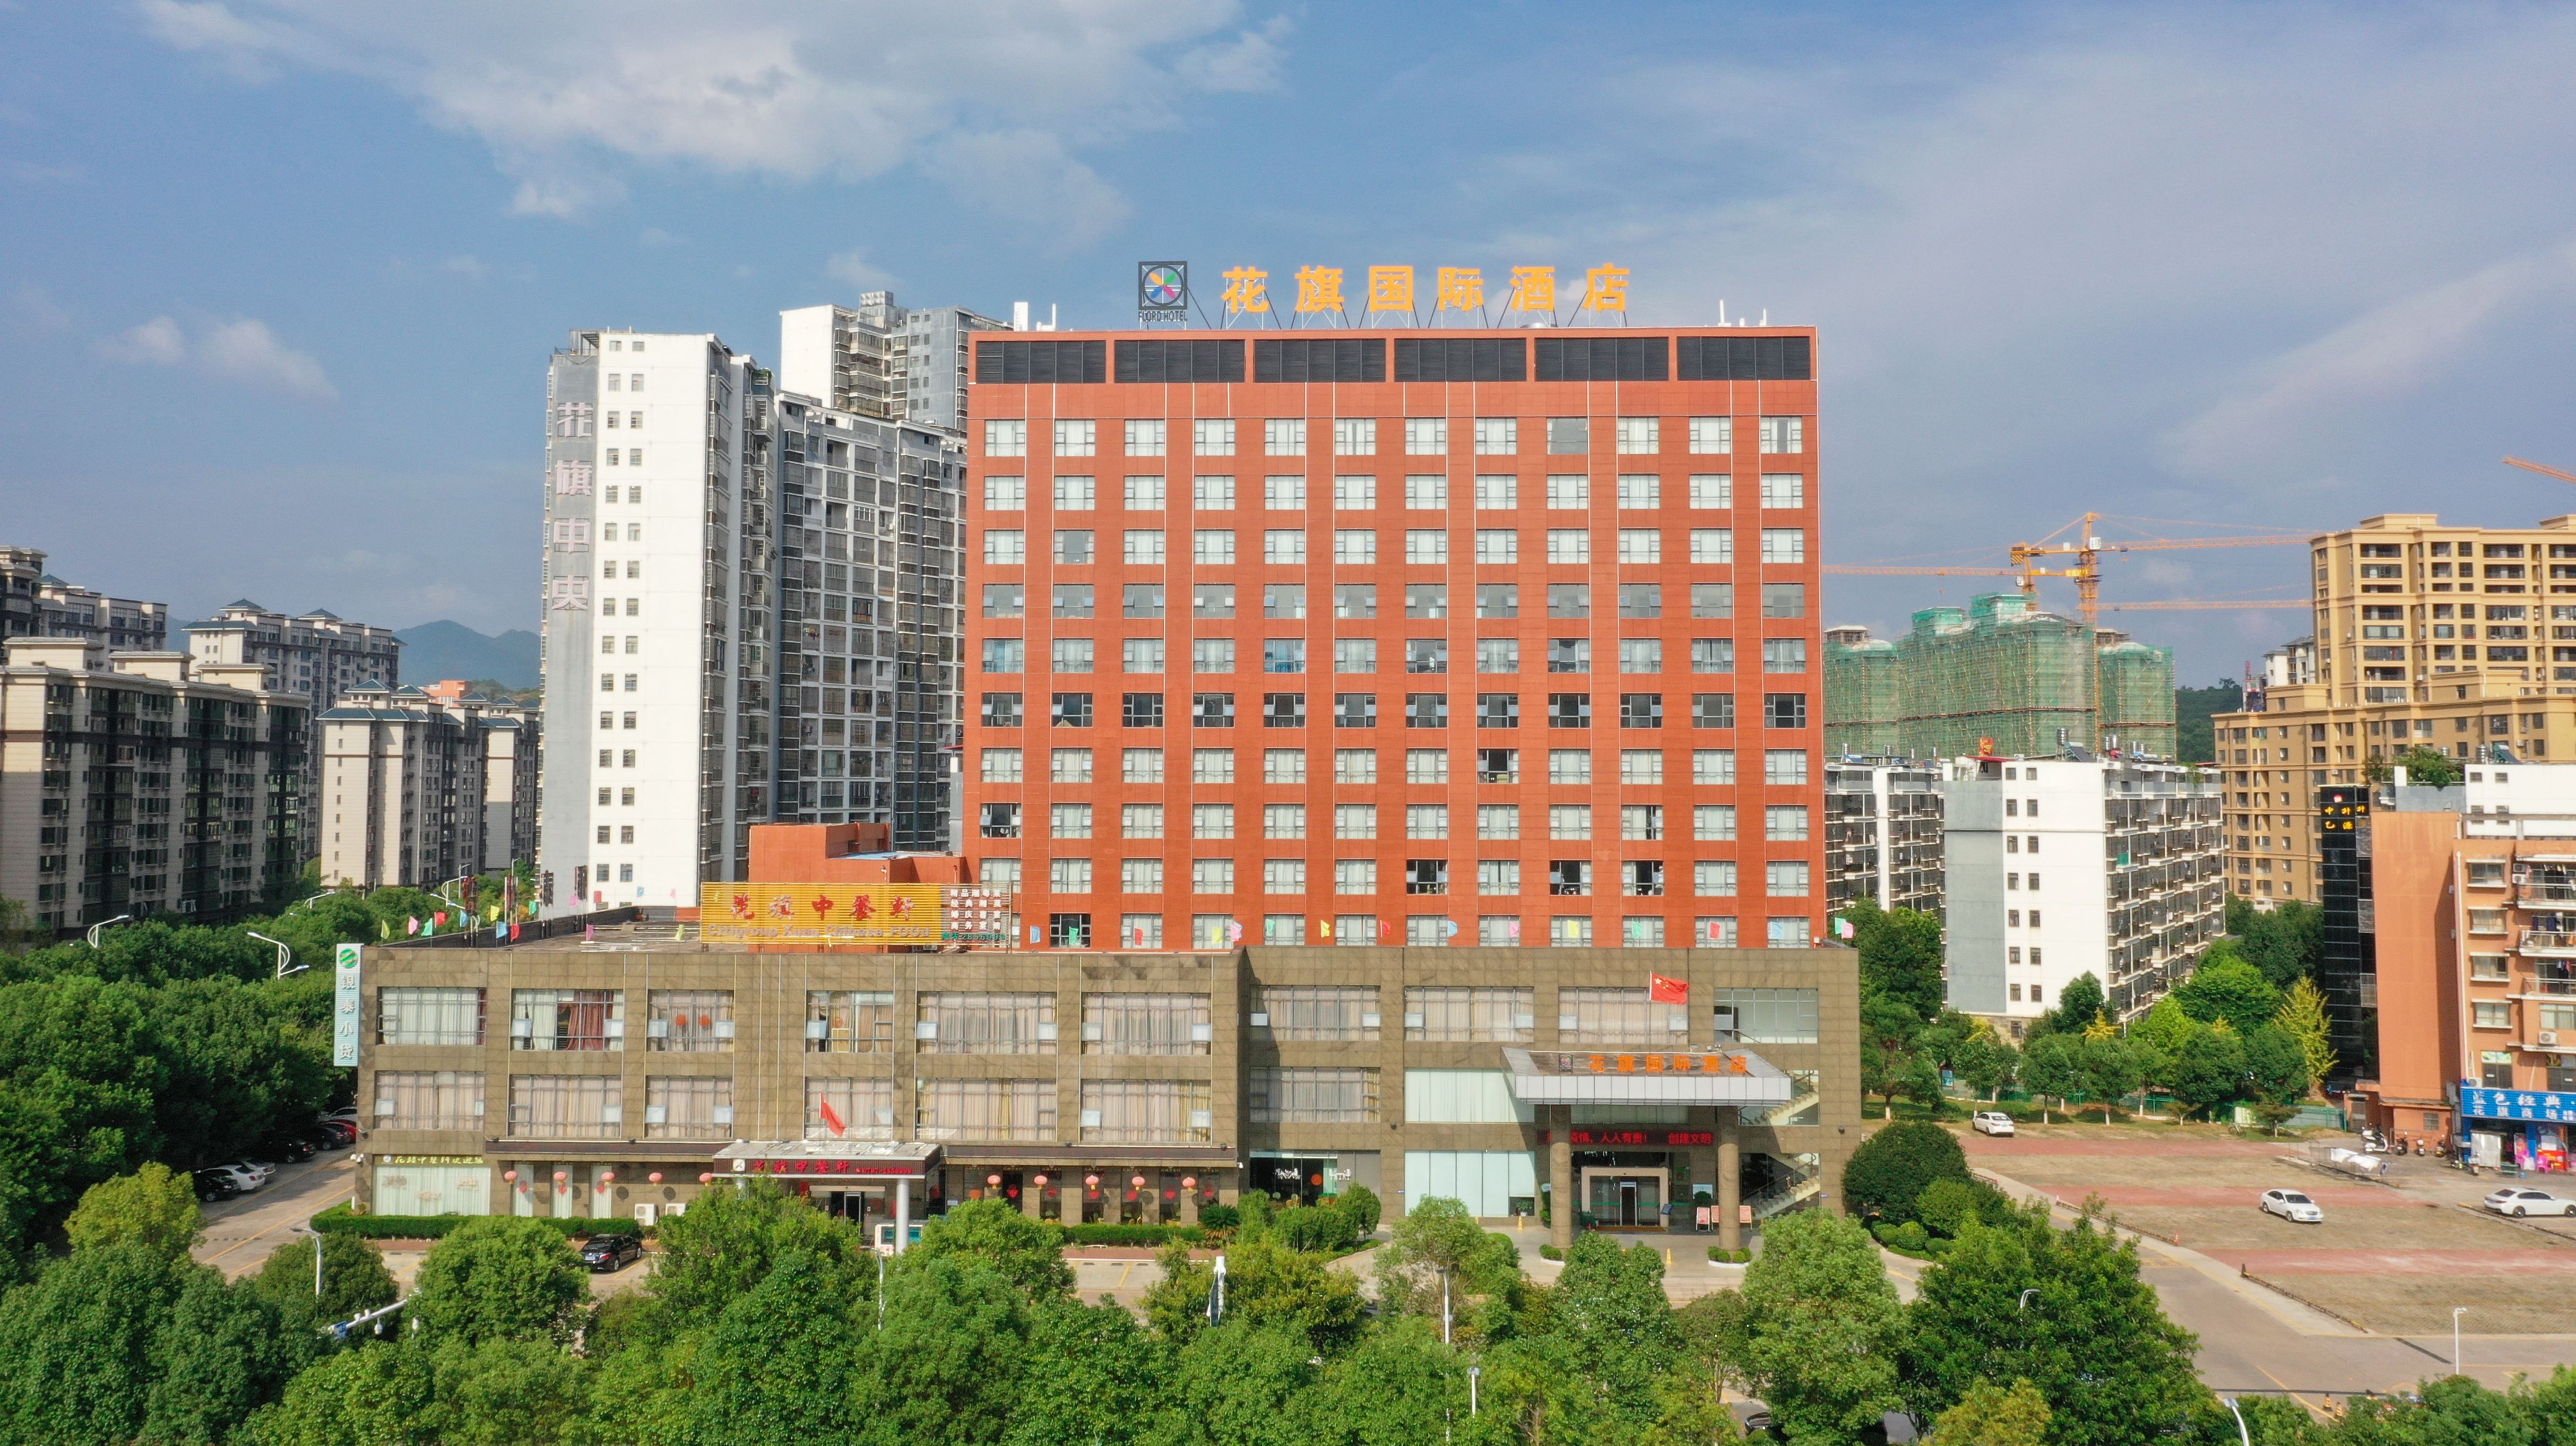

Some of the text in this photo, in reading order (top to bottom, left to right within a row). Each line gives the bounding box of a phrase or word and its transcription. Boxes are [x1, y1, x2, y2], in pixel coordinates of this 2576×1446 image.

[1222, 263, 1630, 313] 花旗国际酒店
[1164, 310, 1187, 321] HOTEL
[552, 402, 593, 610] 花旗中央
[340, 976, 356, 1060] 银泰小贷
[1588, 1054, 1747, 1073] 花旗国际酒店
